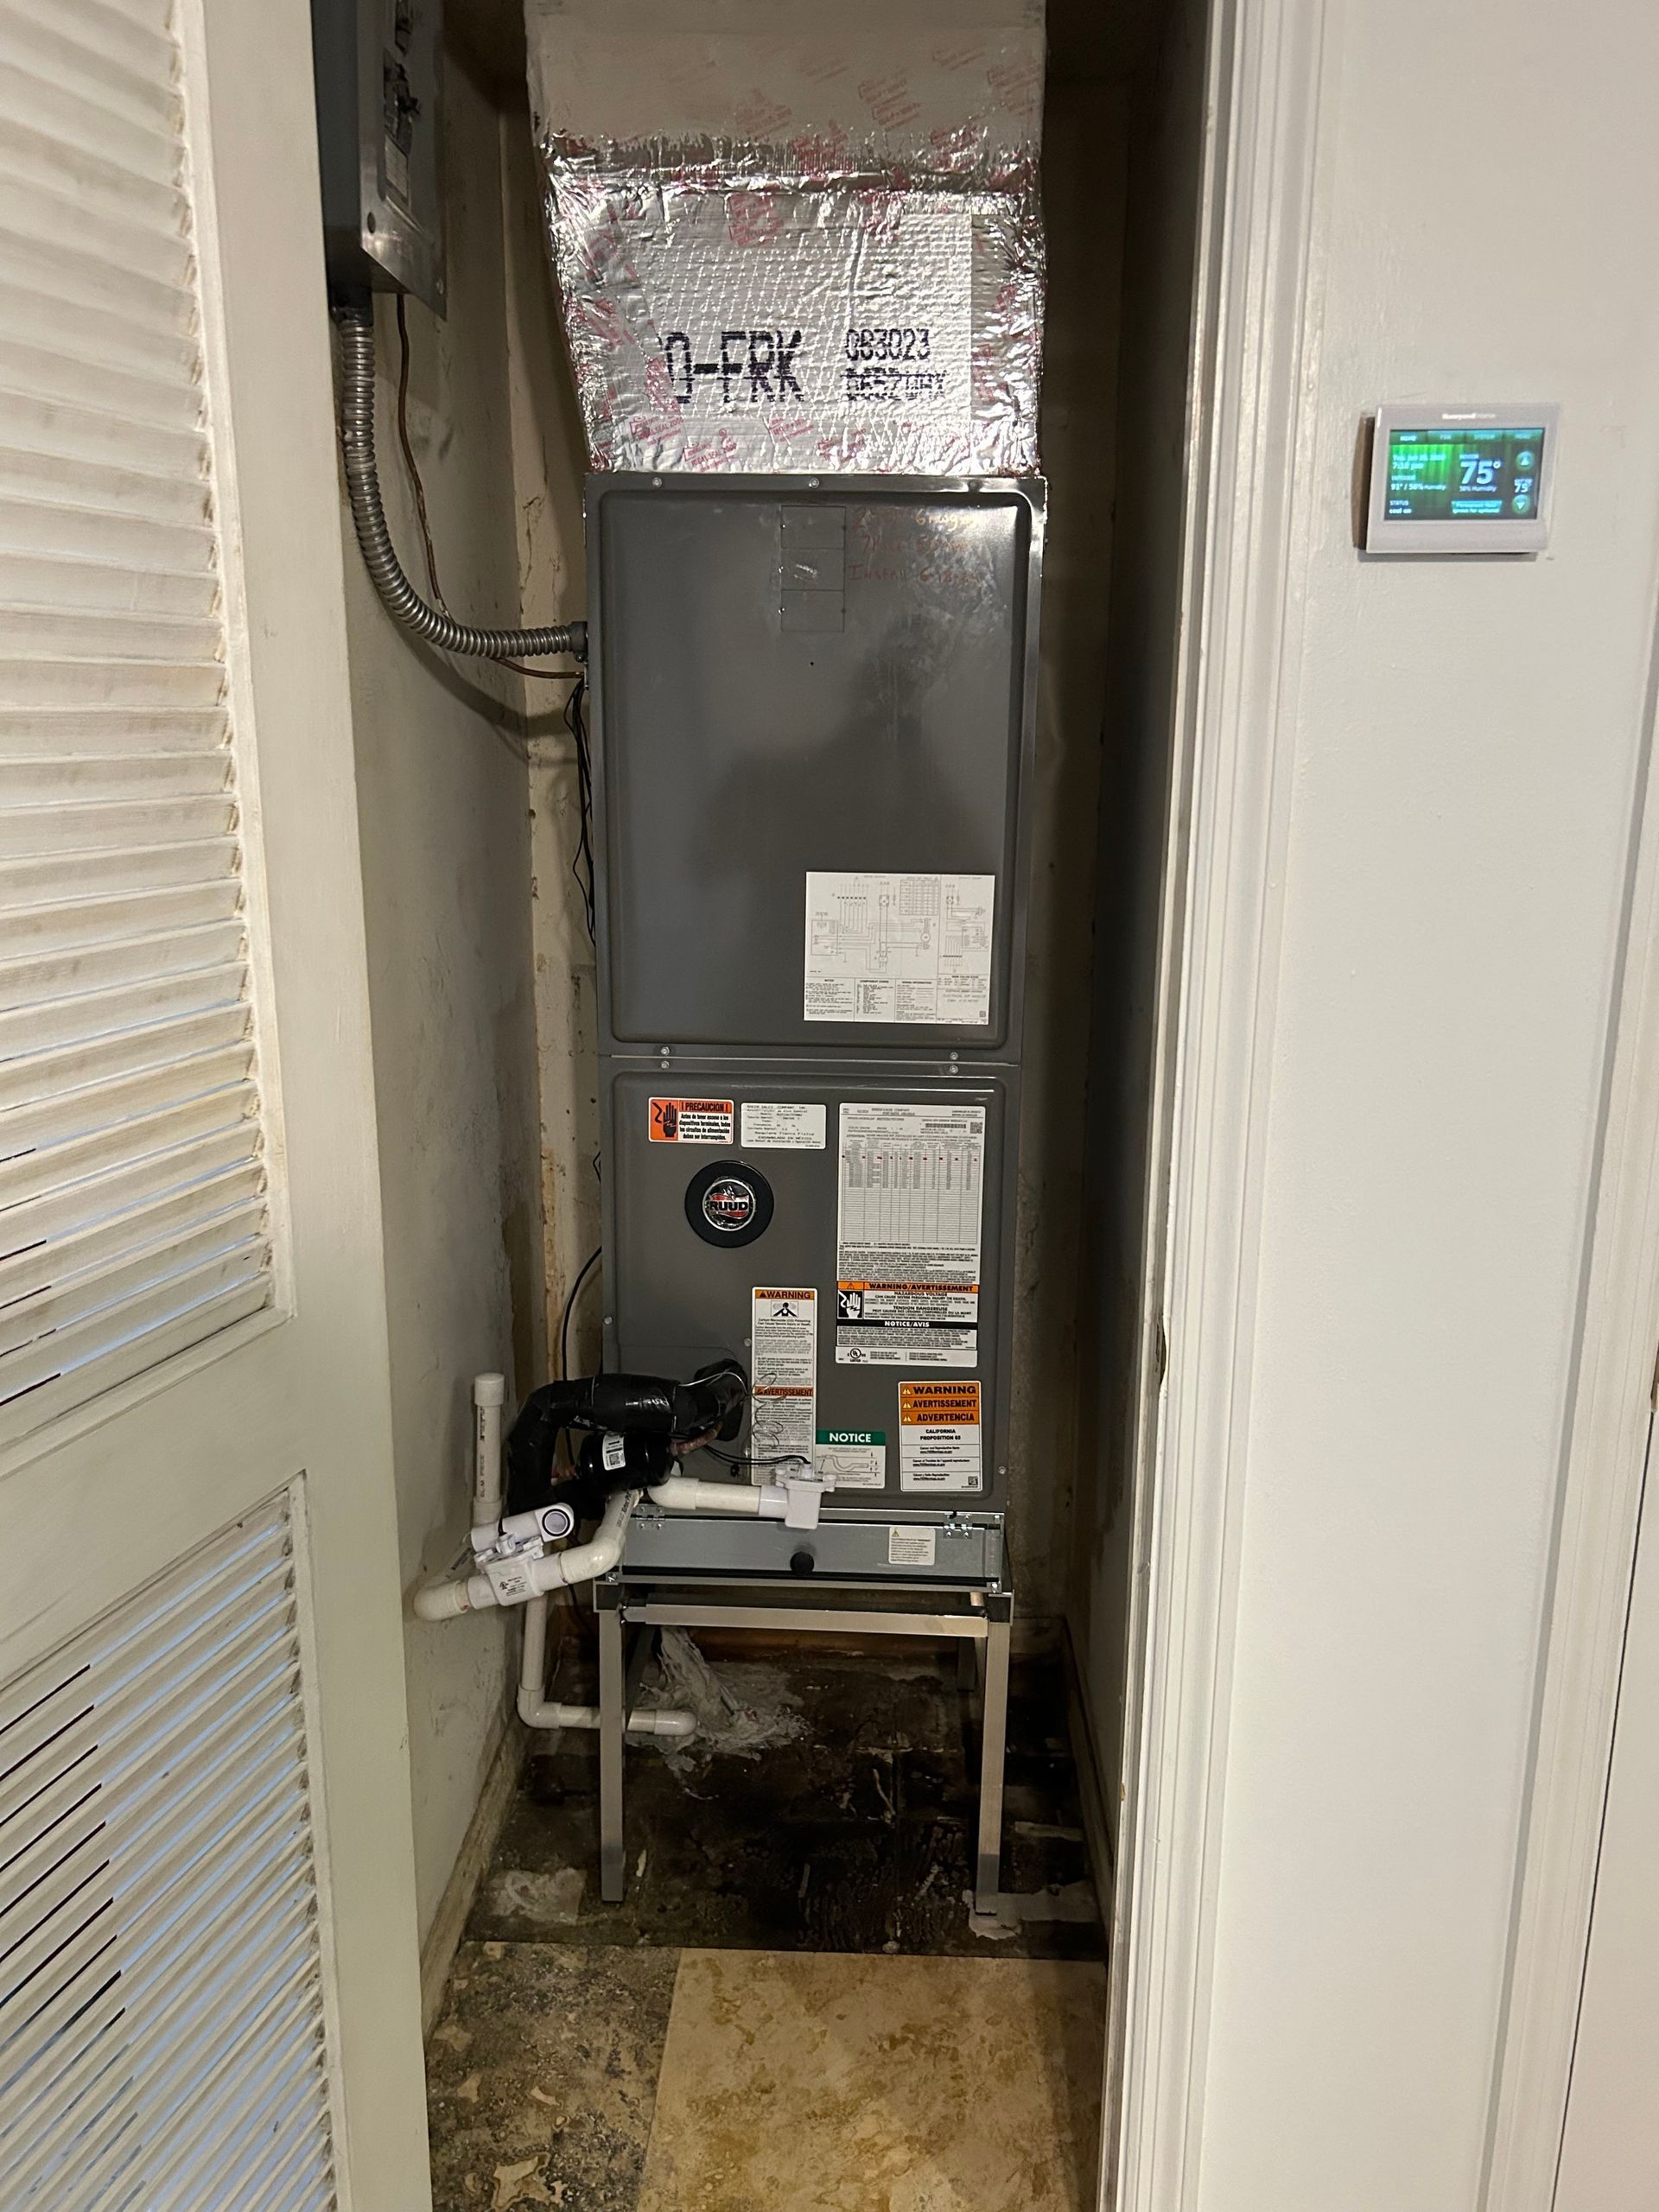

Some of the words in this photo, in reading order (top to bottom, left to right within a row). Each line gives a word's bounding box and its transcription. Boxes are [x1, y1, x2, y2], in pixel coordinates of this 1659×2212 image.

[685, 1103, 724, 1112] PRECAUCION
[709, 1201, 748, 1211] RUUD
[869, 1283, 973, 1291] WARNING/AVERTISSEMENT
[766, 1291, 811, 1299] WARNING
[764, 1388, 812, 1396] AVERTISSEMENT
[913, 1386, 976, 1395] WARNING
[913, 1400, 976, 1408] AVERTISSEMENT
[917, 1413, 975, 1422] ADVERTENCIA
[829, 1433, 871, 1443] NOTICE
